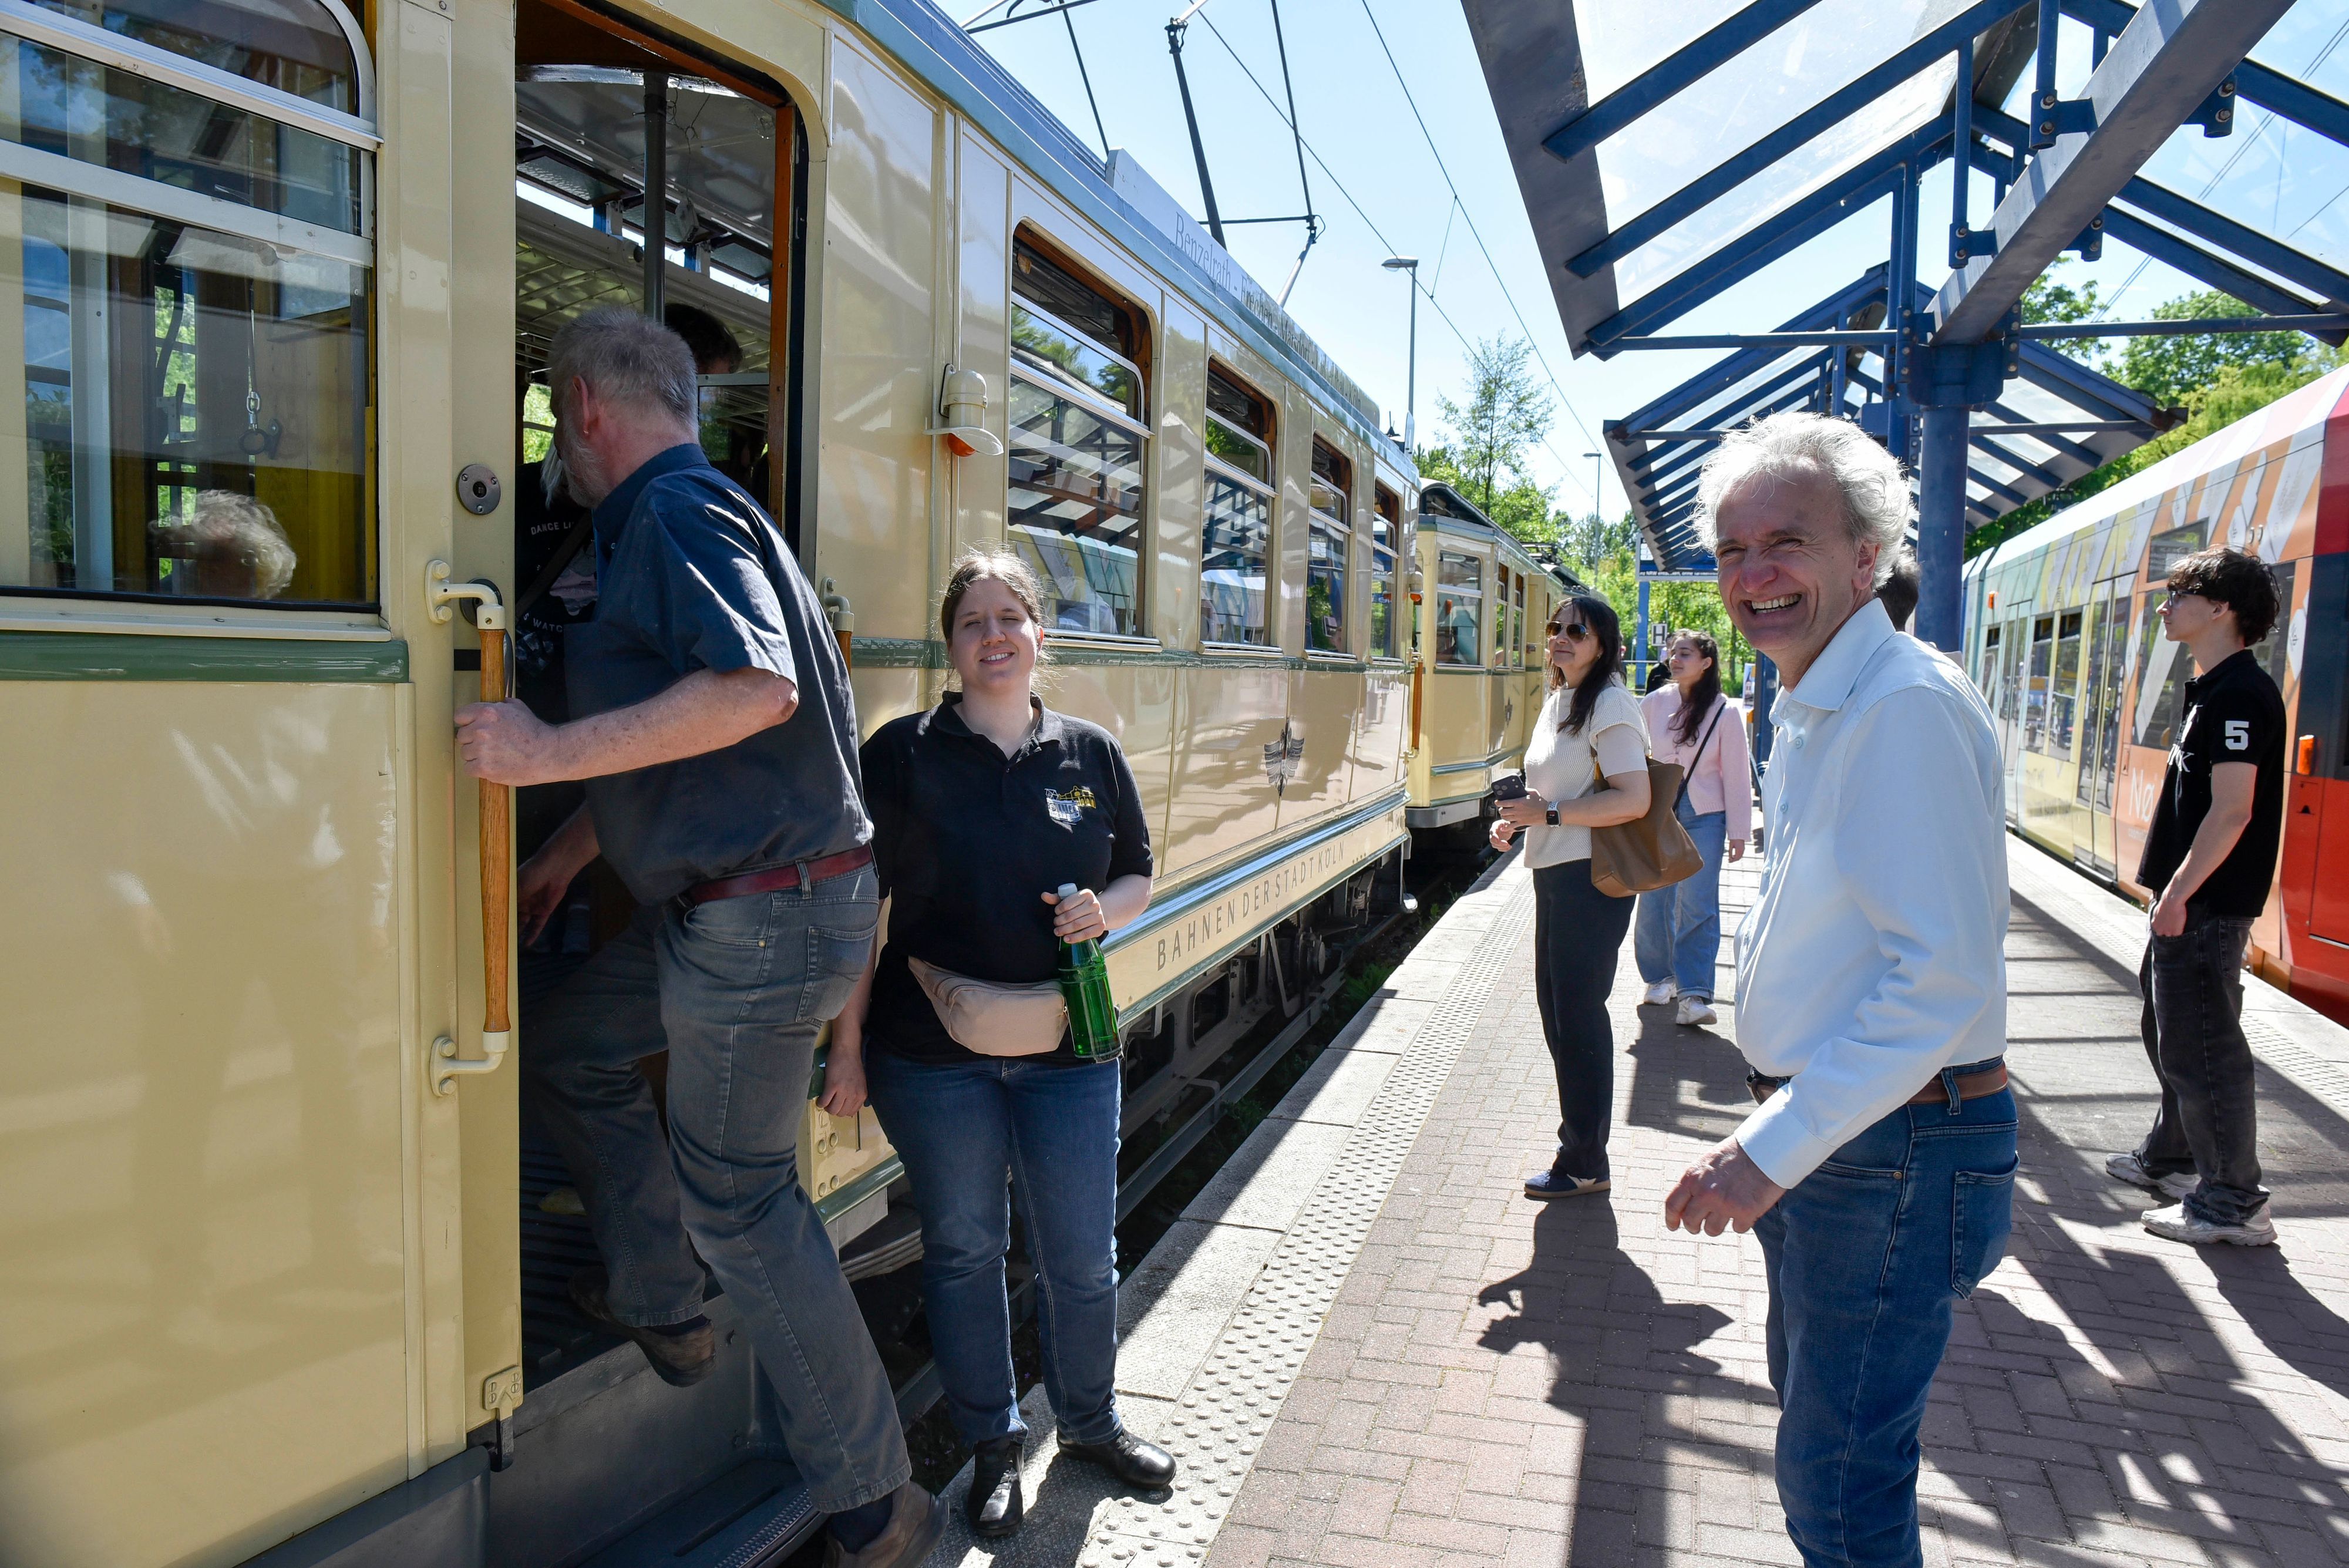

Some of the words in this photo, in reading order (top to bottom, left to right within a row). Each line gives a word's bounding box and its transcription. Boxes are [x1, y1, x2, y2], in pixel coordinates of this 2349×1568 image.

[1176, 211, 1231, 291] Benzelrath
[1240, 274, 1273, 329] Frechen
[531, 521, 560, 536] DANCE
[533, 617, 564, 633] WATC
[1653, 625, 1665, 644] H
[2225, 720, 2249, 750] 5
[1157, 899, 1235, 971] BAHNEN
[1243, 880, 1269, 918] DER
[1276, 857, 1314, 898] STADT
[1318, 841, 1344, 873] KÖLN
